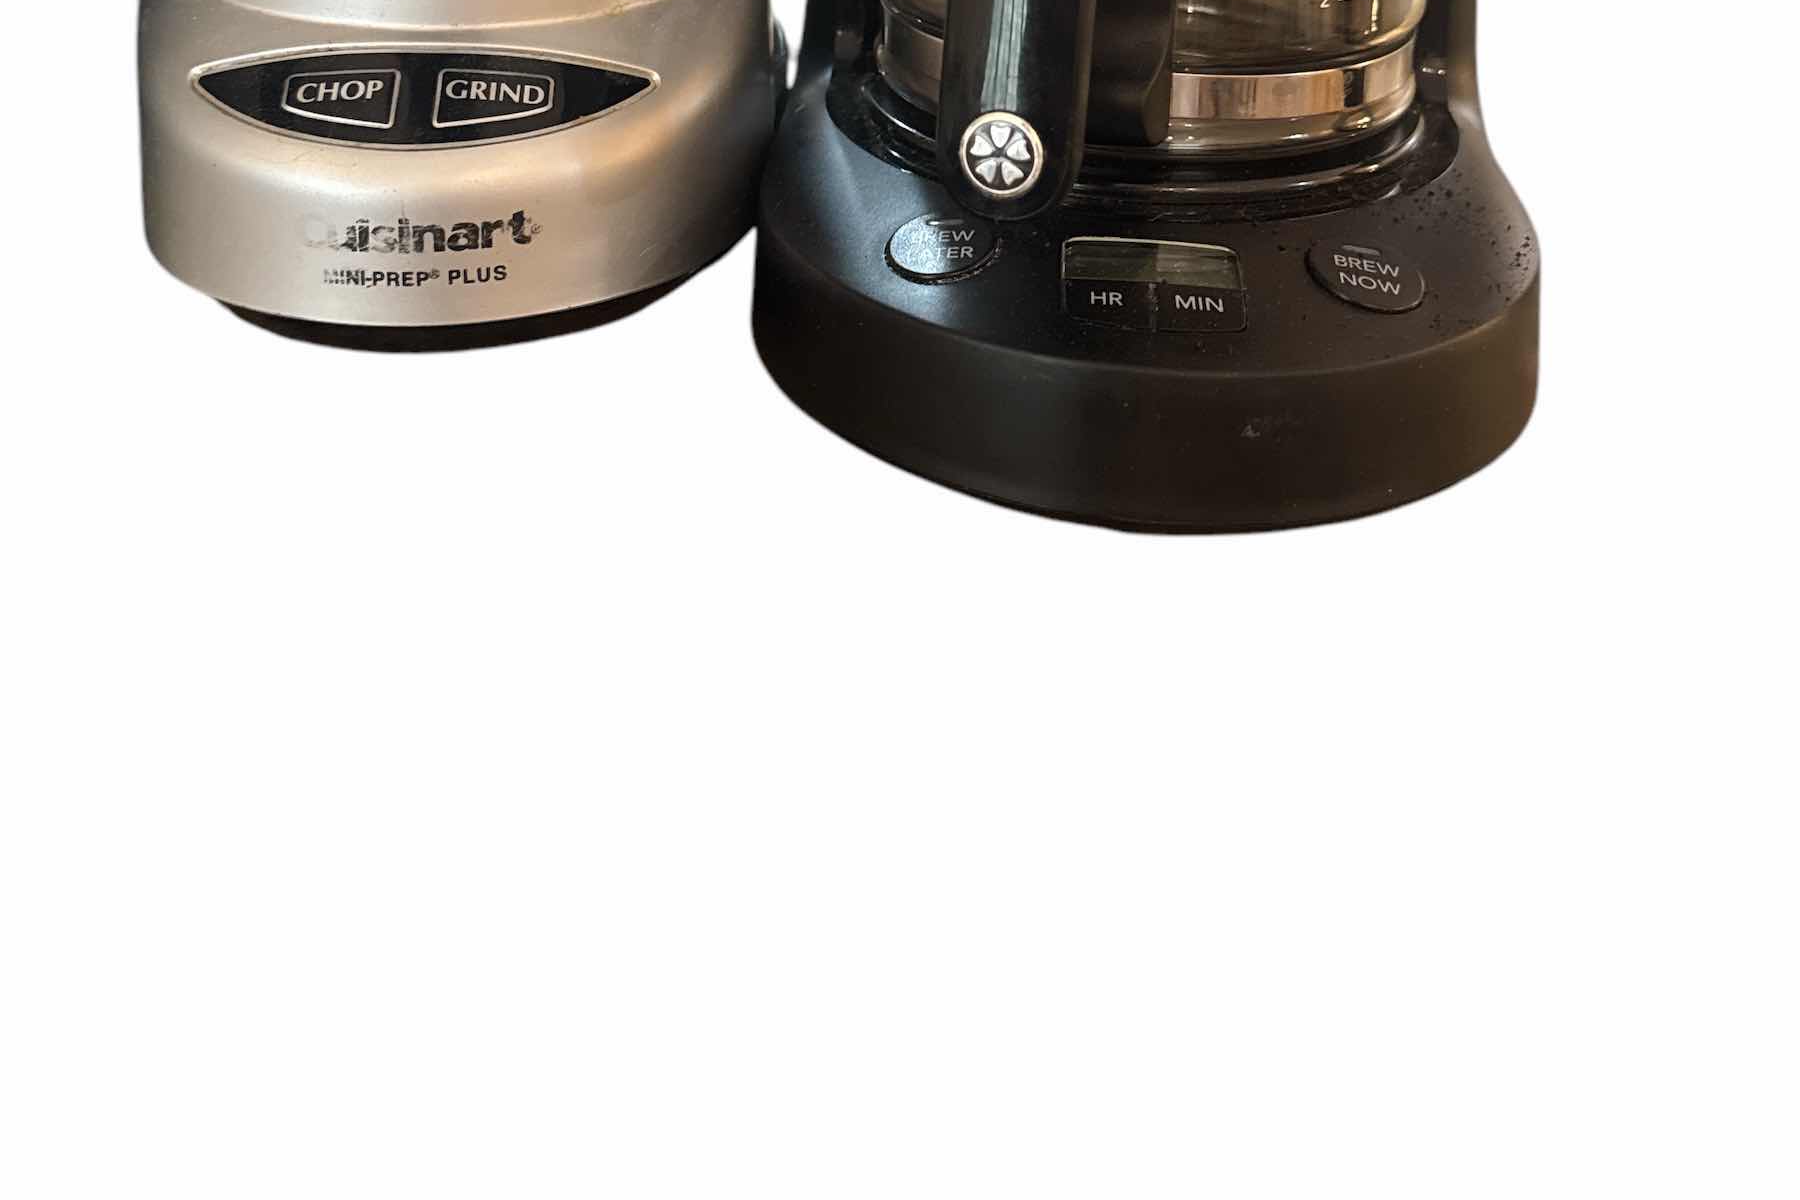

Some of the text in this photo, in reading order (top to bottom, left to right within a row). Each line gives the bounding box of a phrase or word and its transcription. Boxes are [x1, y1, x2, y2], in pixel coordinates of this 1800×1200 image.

[296, 79, 385, 104] CHOP
[445, 79, 546, 106] GRIND
[447, 264, 508, 286] PLUS
[1333, 253, 1400, 278] BREW
[1338, 271, 1401, 296] NOW
[1090, 290, 1225, 314] HR MIN
